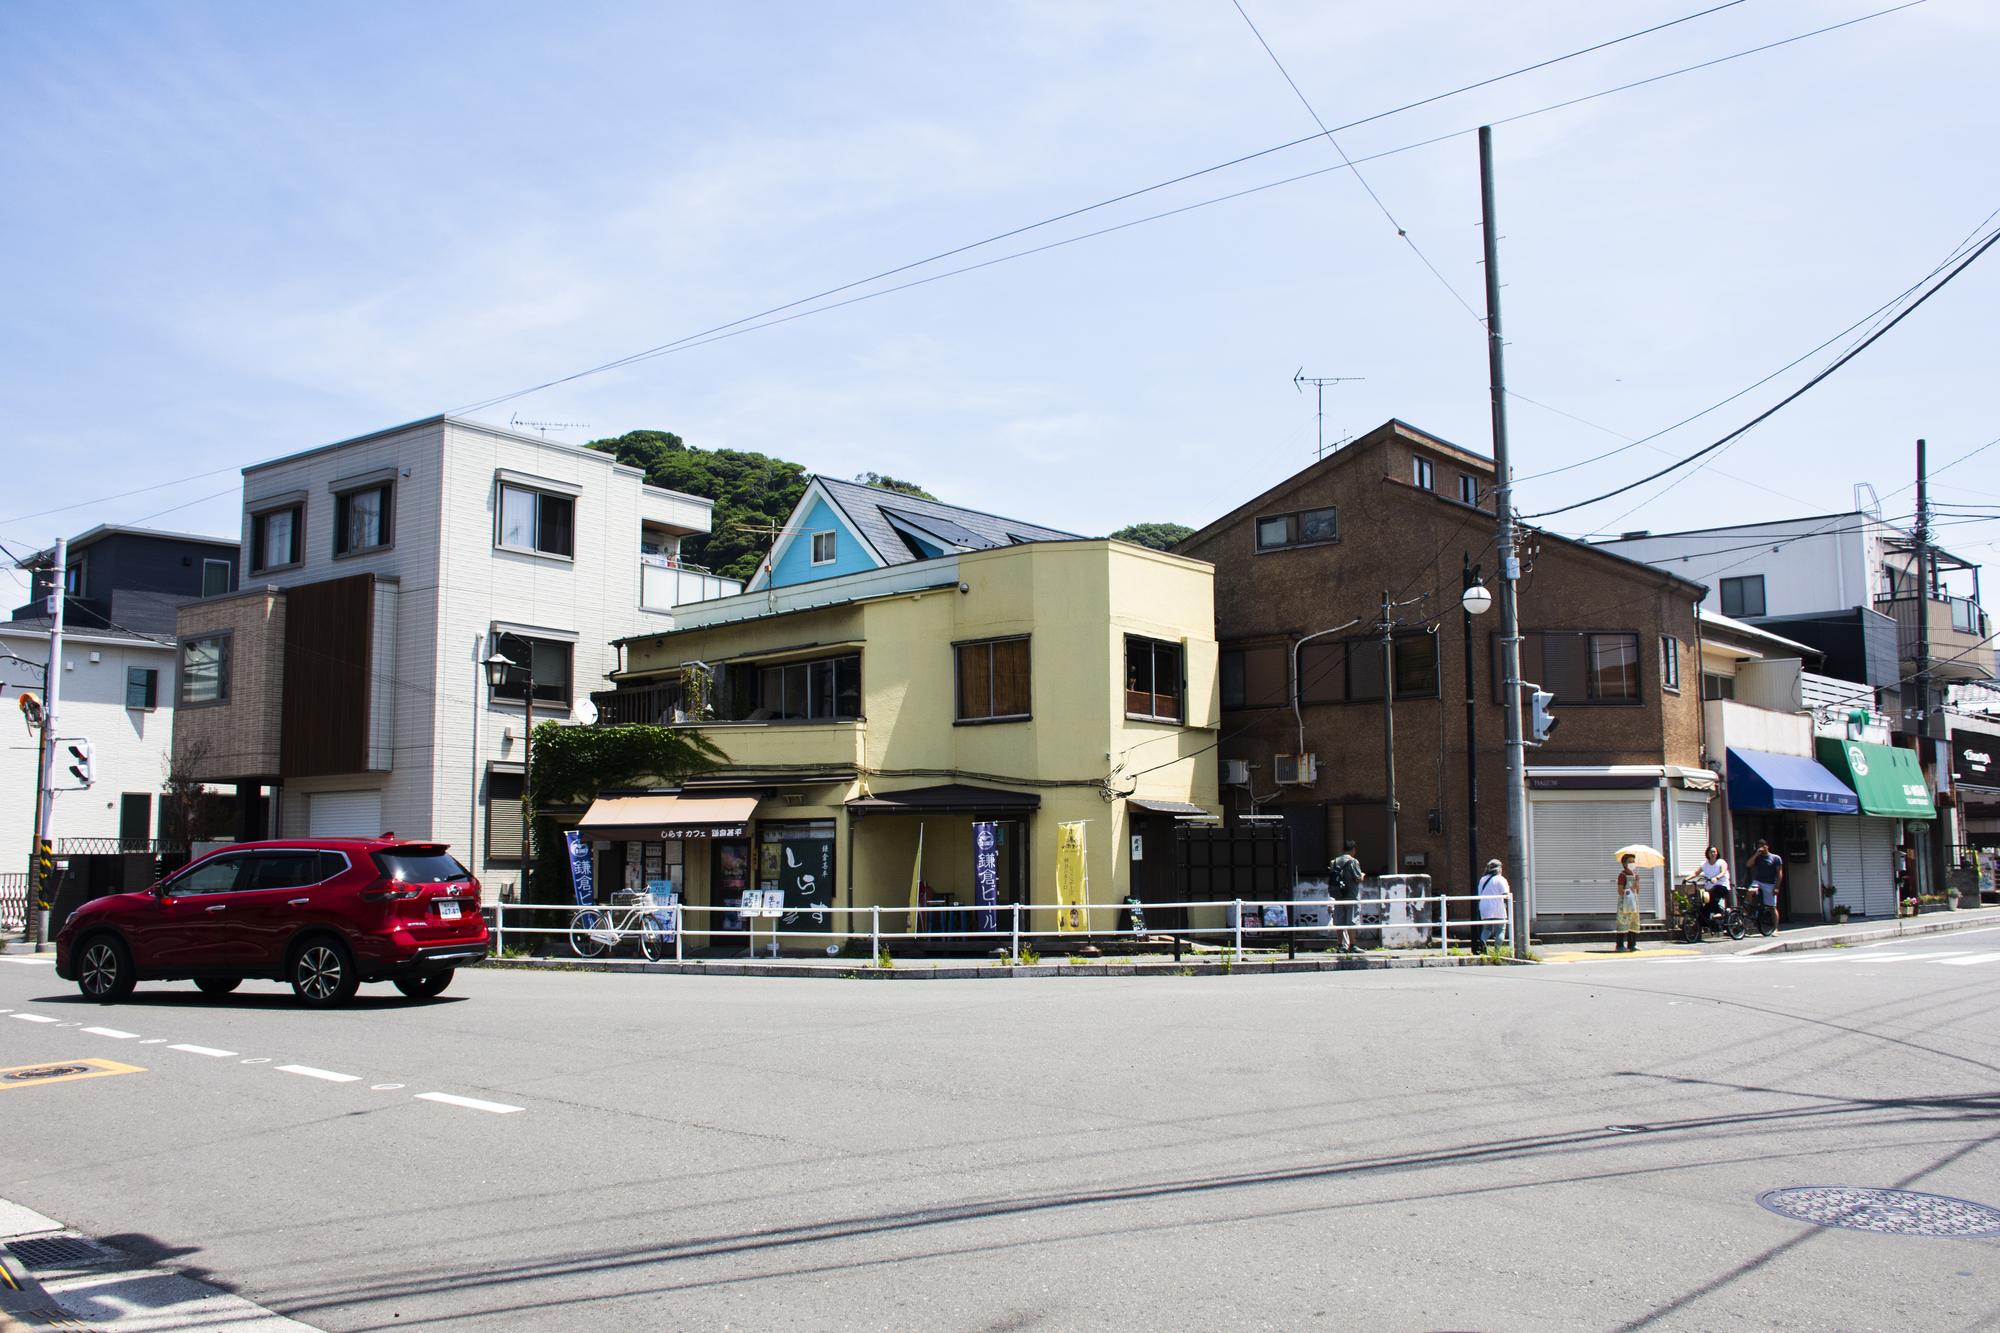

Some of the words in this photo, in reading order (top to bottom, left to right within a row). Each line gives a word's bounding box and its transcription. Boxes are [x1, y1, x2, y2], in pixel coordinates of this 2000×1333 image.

[661, 830, 683, 838] しらす
[685, 830, 706, 838] カフェ
[978, 852, 997, 929] 鎌倉ビール
